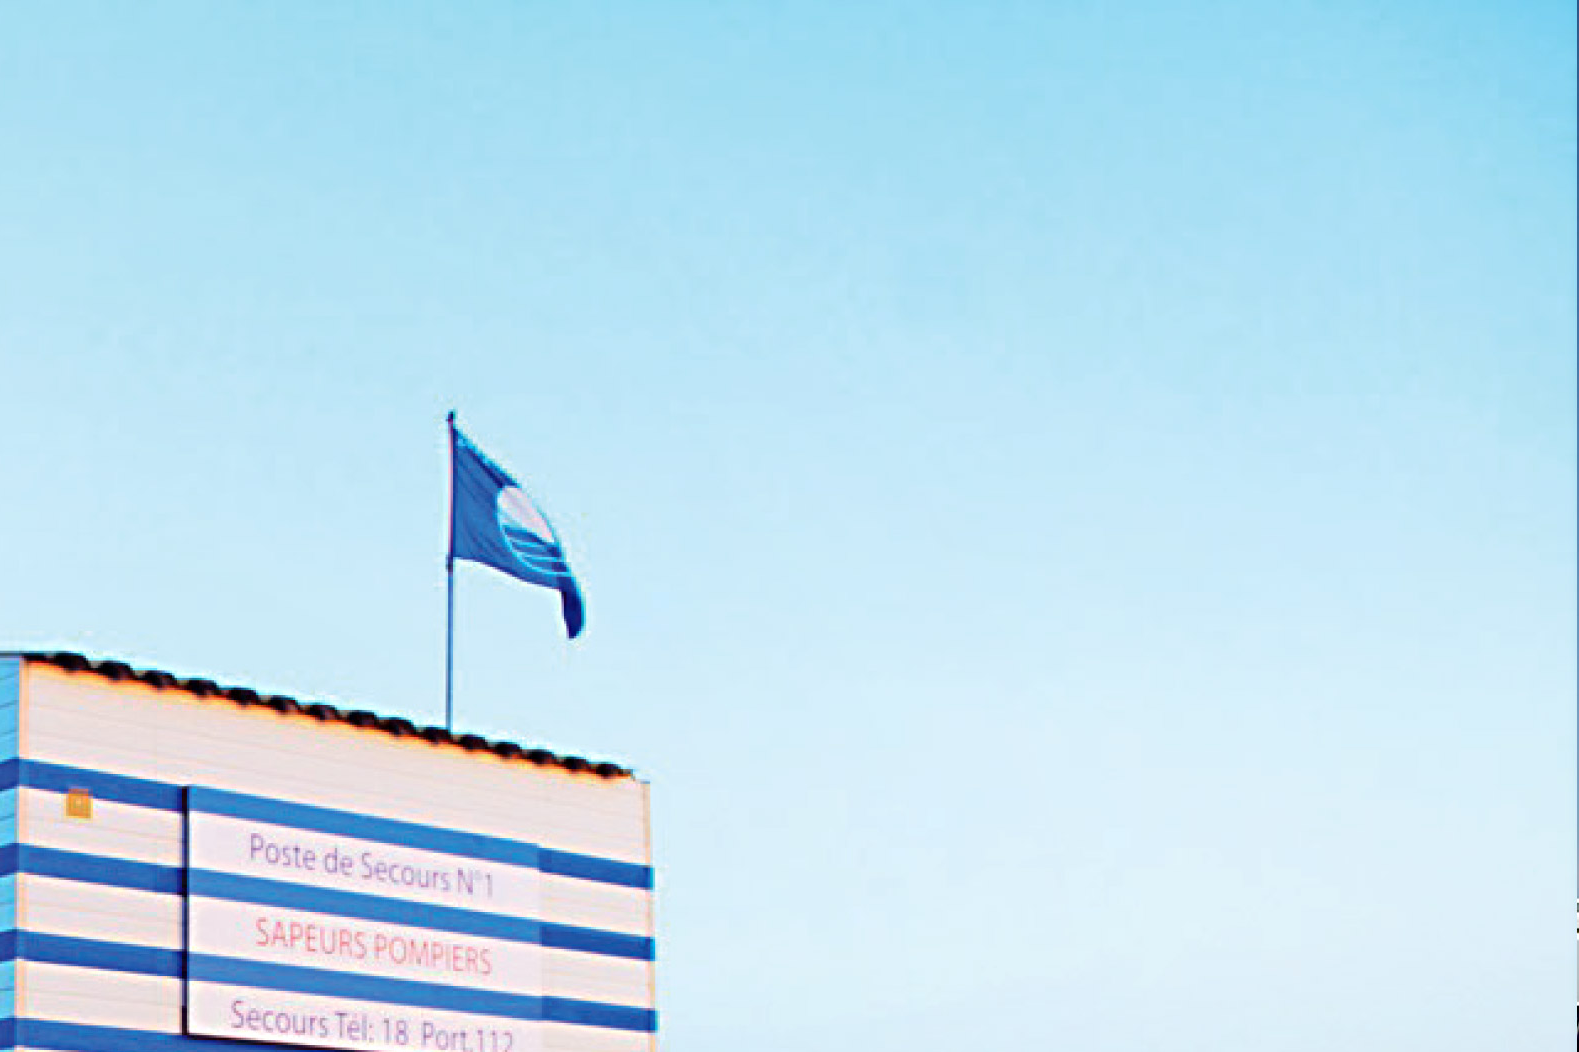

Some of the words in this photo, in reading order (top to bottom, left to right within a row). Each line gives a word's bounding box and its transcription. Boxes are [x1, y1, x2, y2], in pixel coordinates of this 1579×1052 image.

[250, 833, 316, 871] Poste
[324, 847, 353, 876] de
[361, 852, 449, 893] Secours
[457, 868, 493, 897] N°1
[256, 917, 367, 960] SAPEURS
[374, 935, 492, 976] POMPIERS
[231, 1000, 328, 1038] Secours
[383, 1017, 409, 1046] 18
